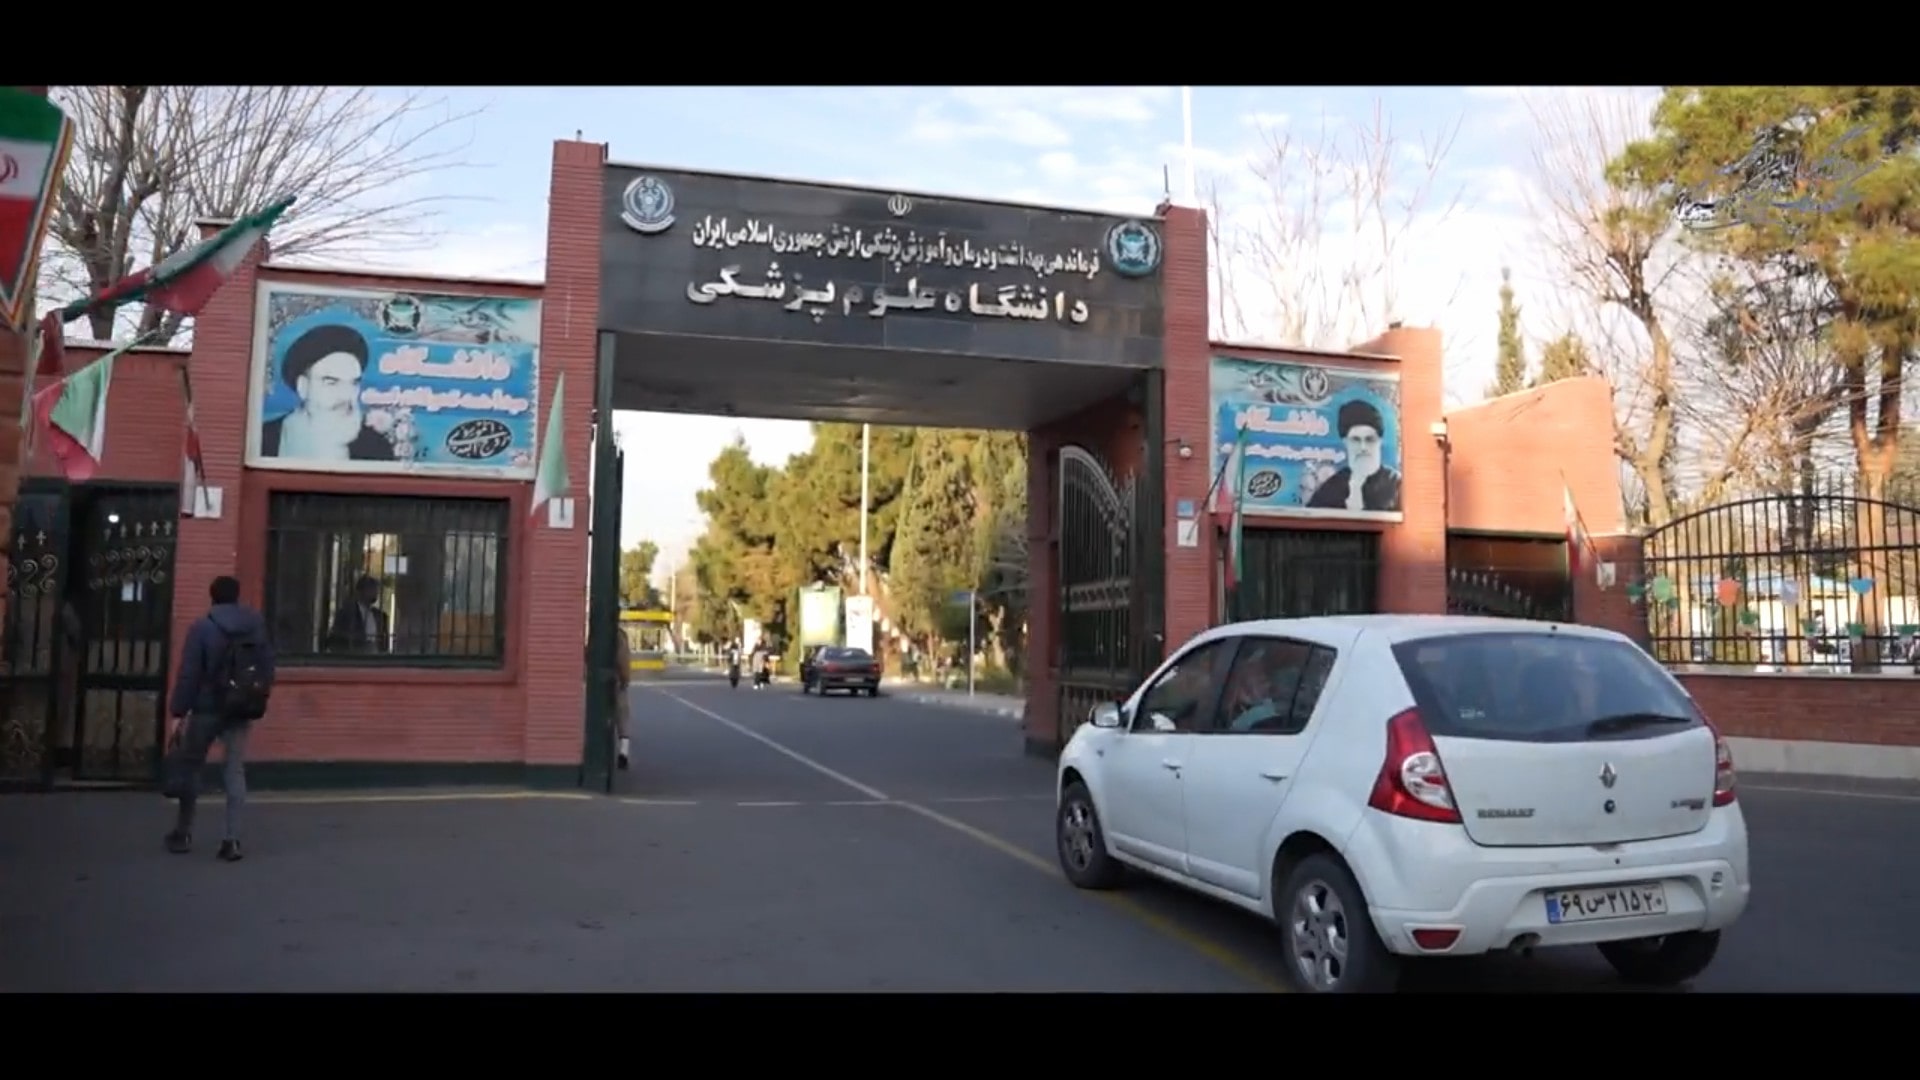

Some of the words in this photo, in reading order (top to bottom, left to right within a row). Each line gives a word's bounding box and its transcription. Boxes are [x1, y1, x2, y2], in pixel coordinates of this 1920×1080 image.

[692, 215, 727, 249] ایران
[726, 218, 774, 248] اسلامی
[772, 231, 827, 257] جمهوری
[827, 223, 862, 257] ارتش
[901, 230, 945, 263] آموزش
[860, 227, 902, 273] پزشکی
[943, 245, 953, 266] و
[953, 239, 990, 268] درمان
[989, 250, 997, 270] و
[998, 239, 1044, 278] بهداشت
[1044, 247, 1100, 280] فرماندهی
[687, 261, 836, 324] پزشکی
[842, 276, 936, 317] علوم
[944, 282, 1088, 323] دانشگاه
[379, 344, 510, 380] دانشگاه
[1235, 405, 1330, 436] دانشگاه
